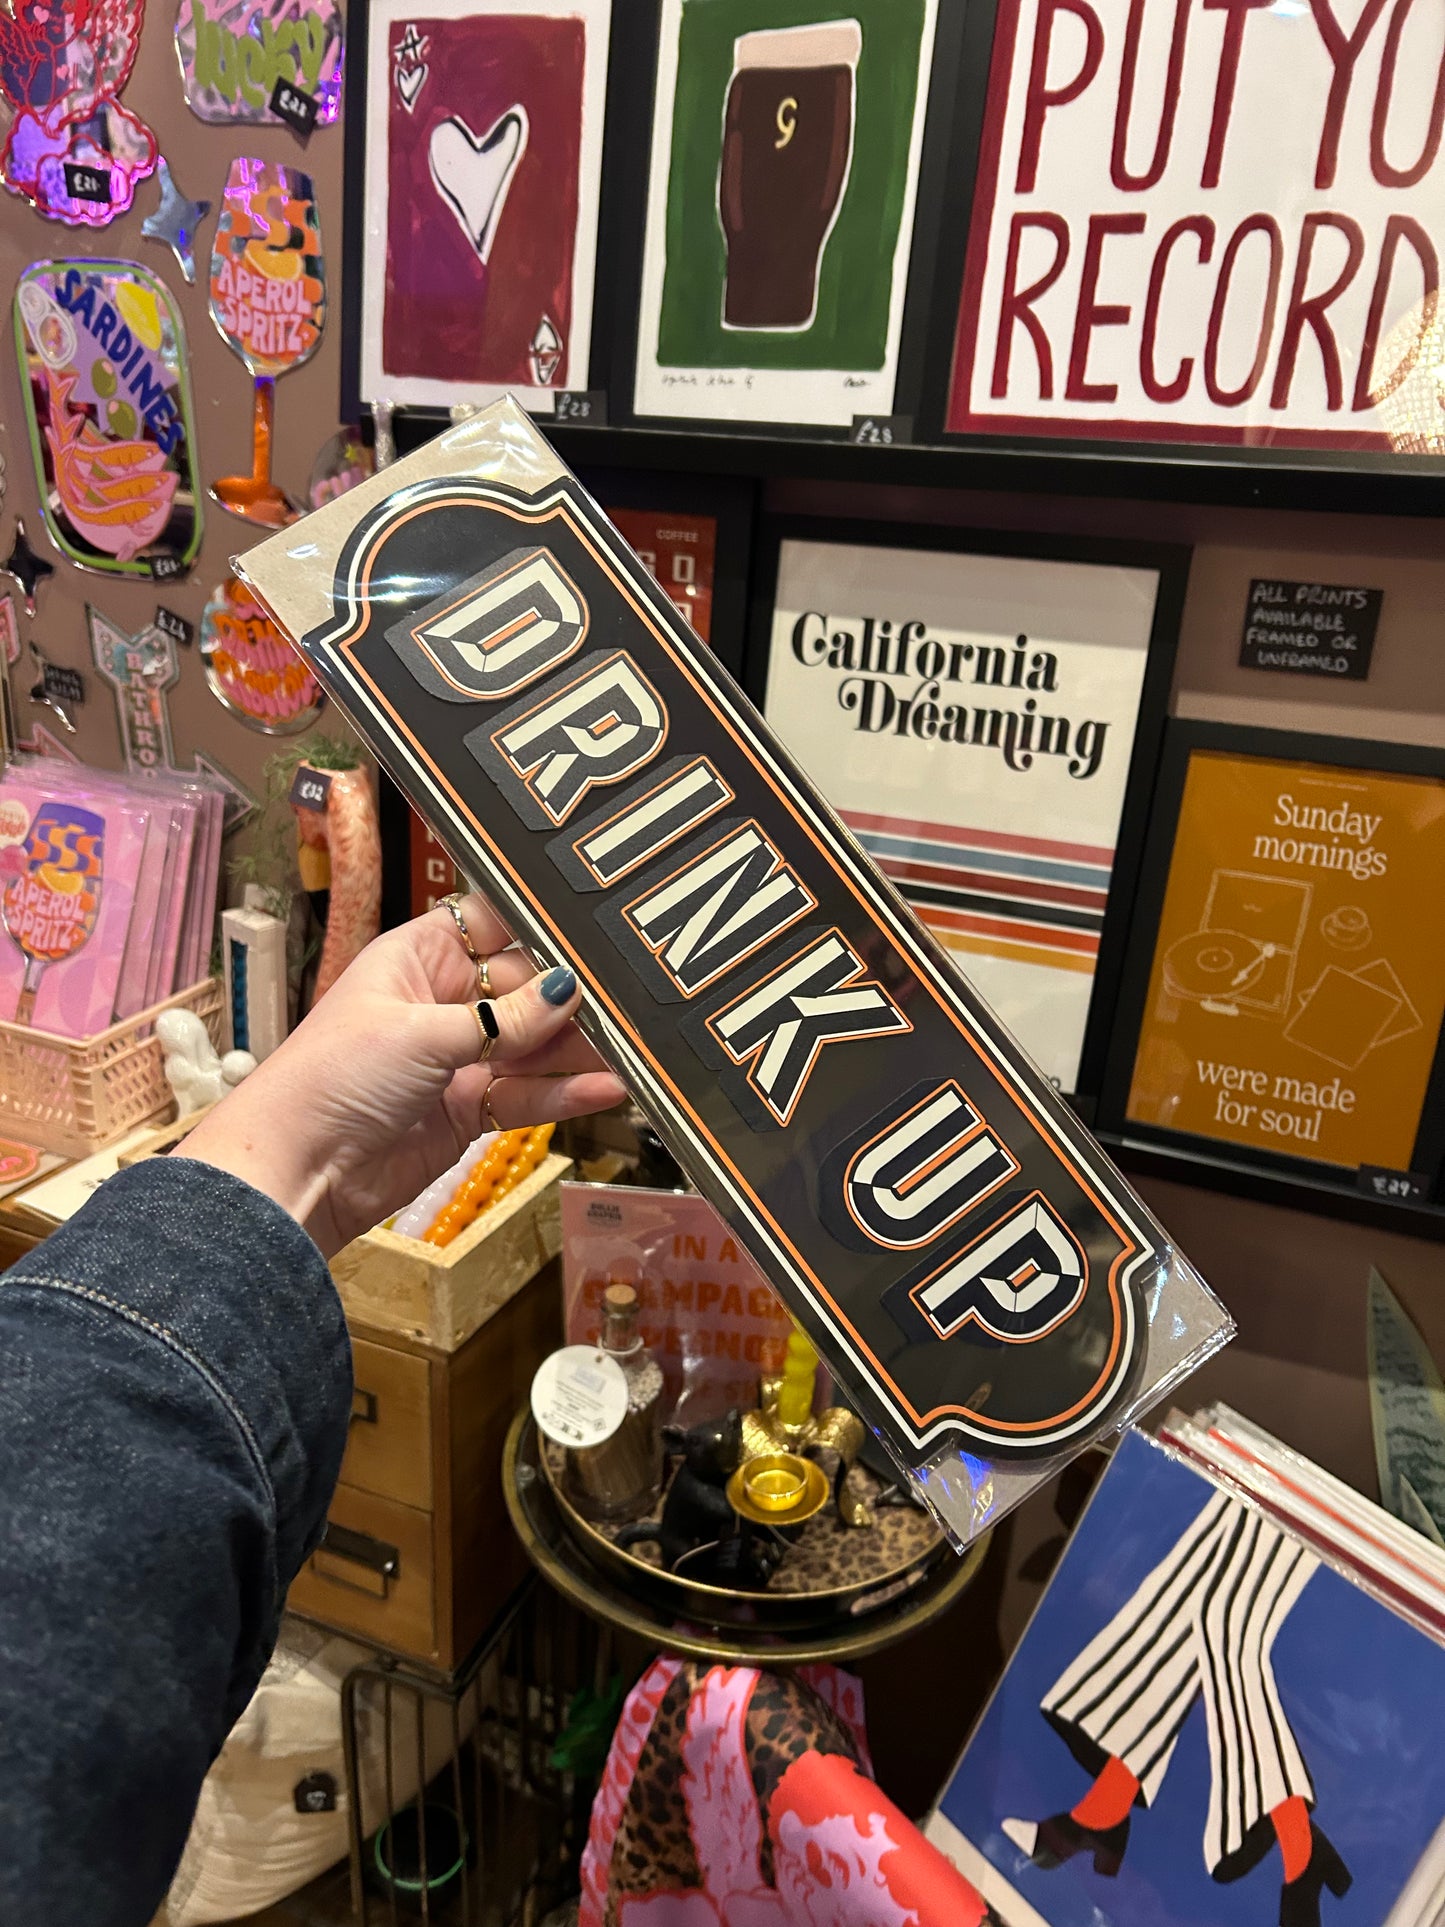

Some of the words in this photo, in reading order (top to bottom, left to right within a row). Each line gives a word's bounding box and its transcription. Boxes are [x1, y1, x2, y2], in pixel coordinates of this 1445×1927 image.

[1014, 0, 1279, 193] PUT
[218, 259, 312, 313] APEROL
[989, 211, 1445, 413] RECORD
[218, 296, 303, 353] SPRITZ
[55, 268, 185, 456] SARDINES
[656, 529, 699, 543] COFFEE
[1253, 583, 1287, 603] ALL
[1296, 585, 1368, 609] PRINTS
[1253, 606, 1345, 632] AVAILABLE
[791, 611, 1060, 692] California
[1246, 626, 1319, 648] FRAMED
[1331, 635, 1357, 650] OR
[1257, 650, 1348, 673] UNFRAMED
[838, 676, 1112, 780] Dreaming
[1274, 793, 1382, 844] Sunday
[1253, 835, 1388, 881] mornings
[10, 877, 85, 919] APEROL
[9, 905, 75, 949] SPRITZ
[400, 546, 914, 1128] DRINK
[838, 1078, 1090, 1344] UP
[1197, 1059, 1268, 1096] were
[1273, 1077, 1356, 1113] made
[1214, 1089, 1257, 1127] for
[1259, 1109, 1323, 1142] soul
[672, 1234, 706, 1261] IN
[718, 1239, 739, 1263] A
